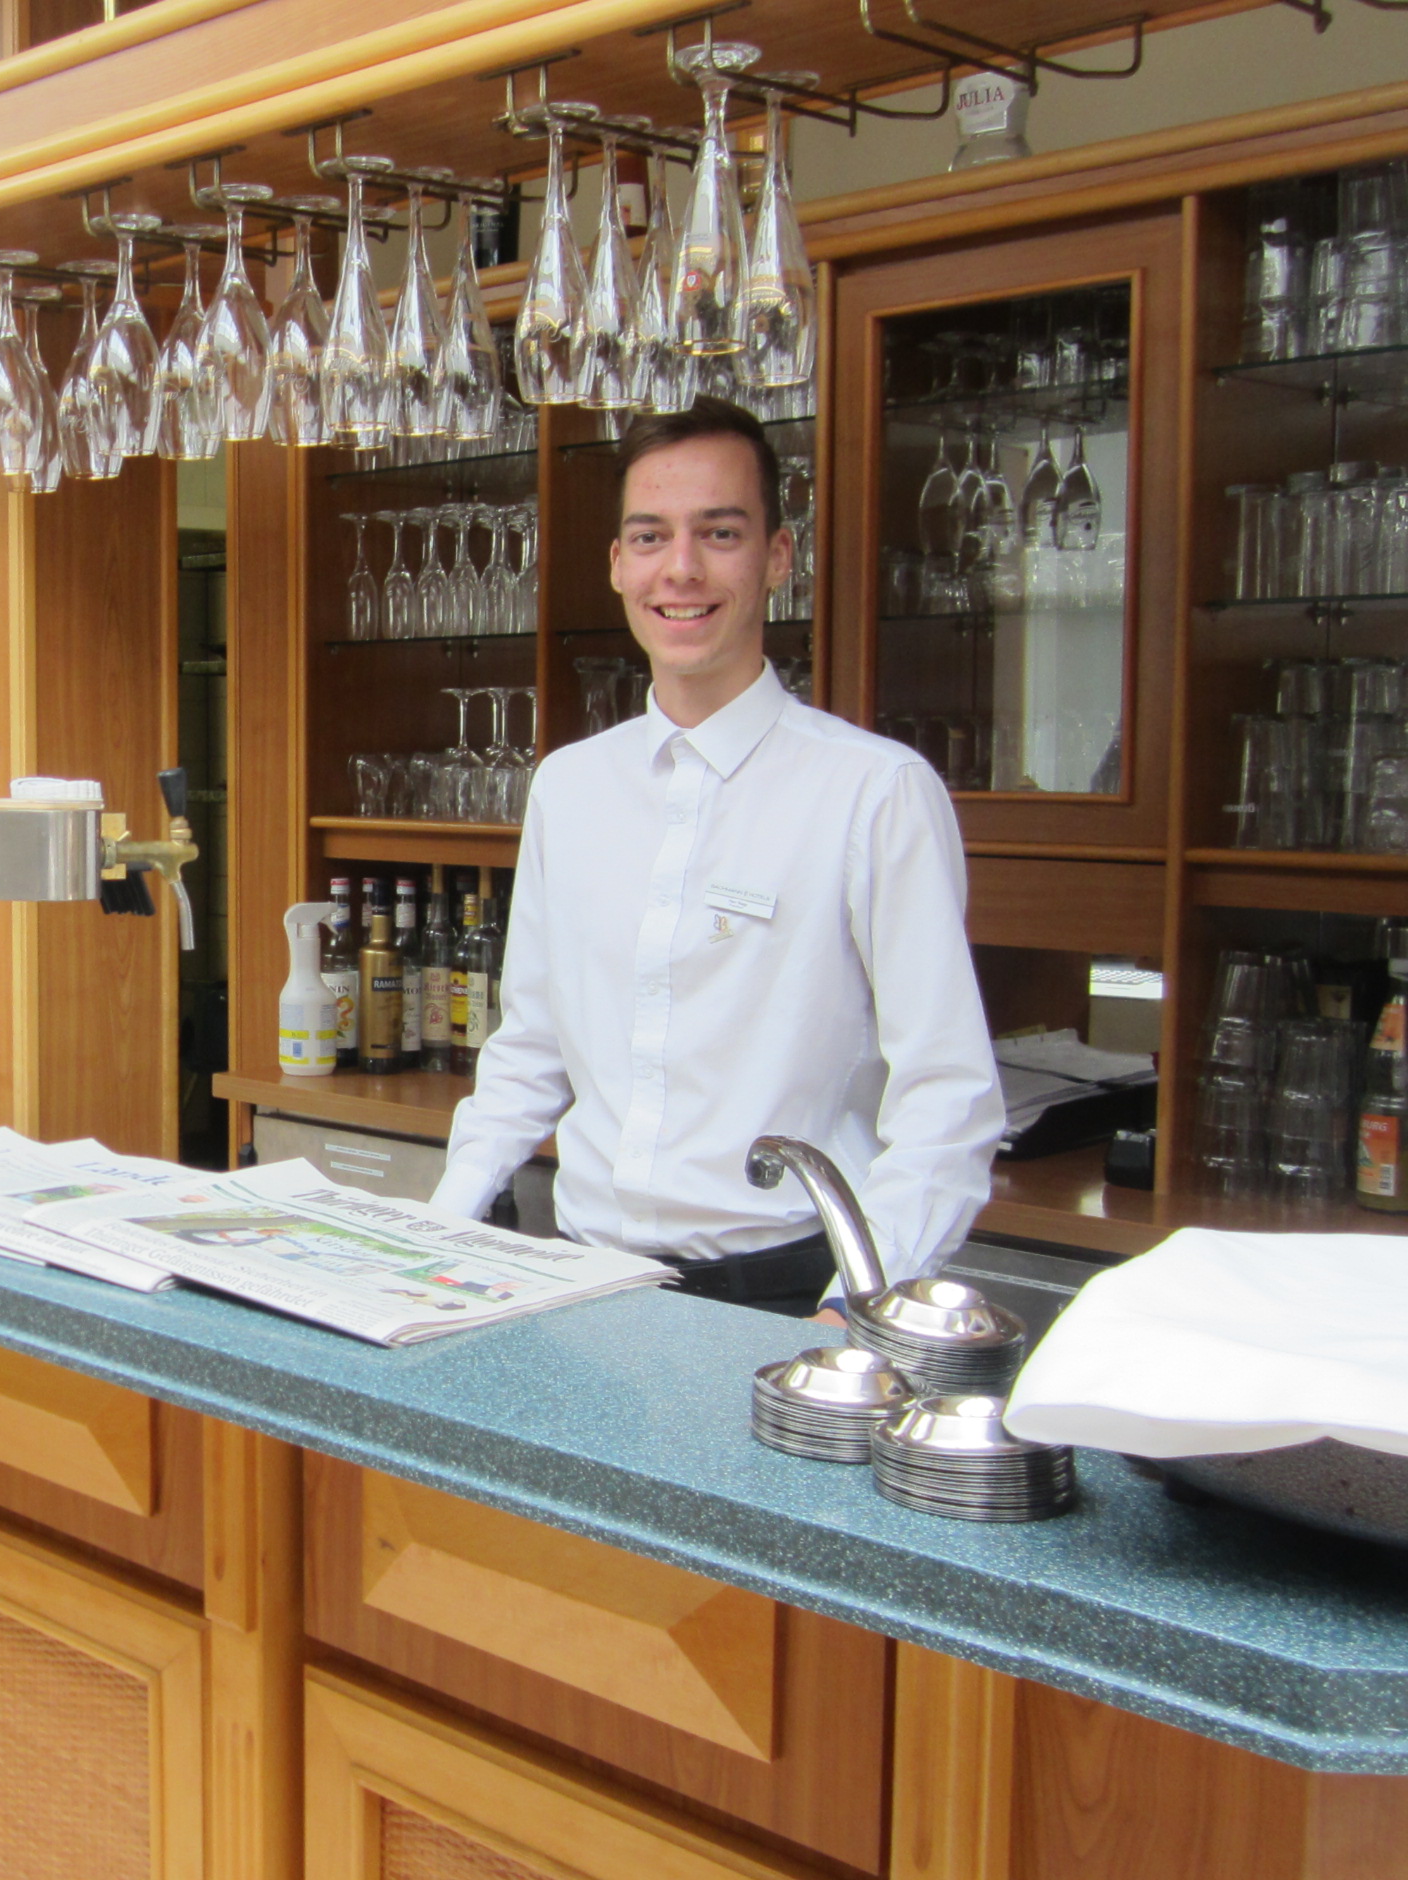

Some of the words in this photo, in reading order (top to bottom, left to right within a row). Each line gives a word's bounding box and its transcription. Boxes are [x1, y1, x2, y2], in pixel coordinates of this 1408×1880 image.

[956, 86, 1005, 111] JULIA
[289, 1188, 418, 1223] Thüringer
[438, 1230, 585, 1263] Allgemeine
